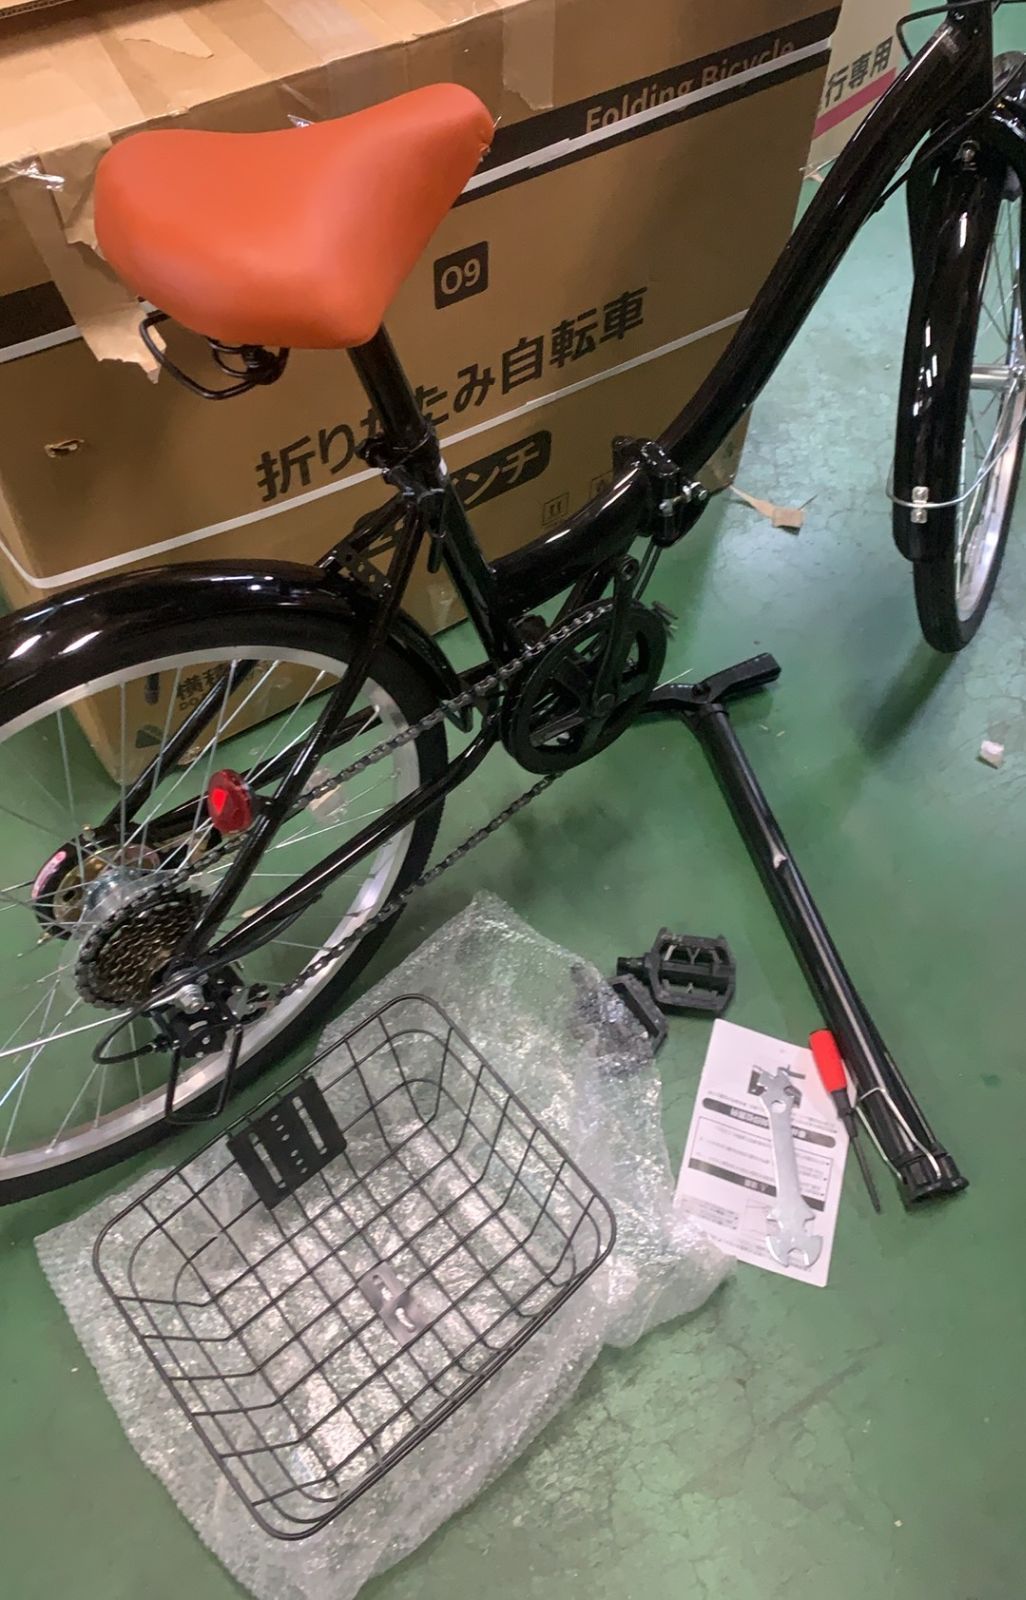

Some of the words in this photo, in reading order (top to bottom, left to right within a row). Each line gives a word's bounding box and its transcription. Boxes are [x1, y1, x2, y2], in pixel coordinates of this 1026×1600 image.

[825, 36, 893, 108] 行専用
[255, 286, 648, 502] 折りたみ自転車
